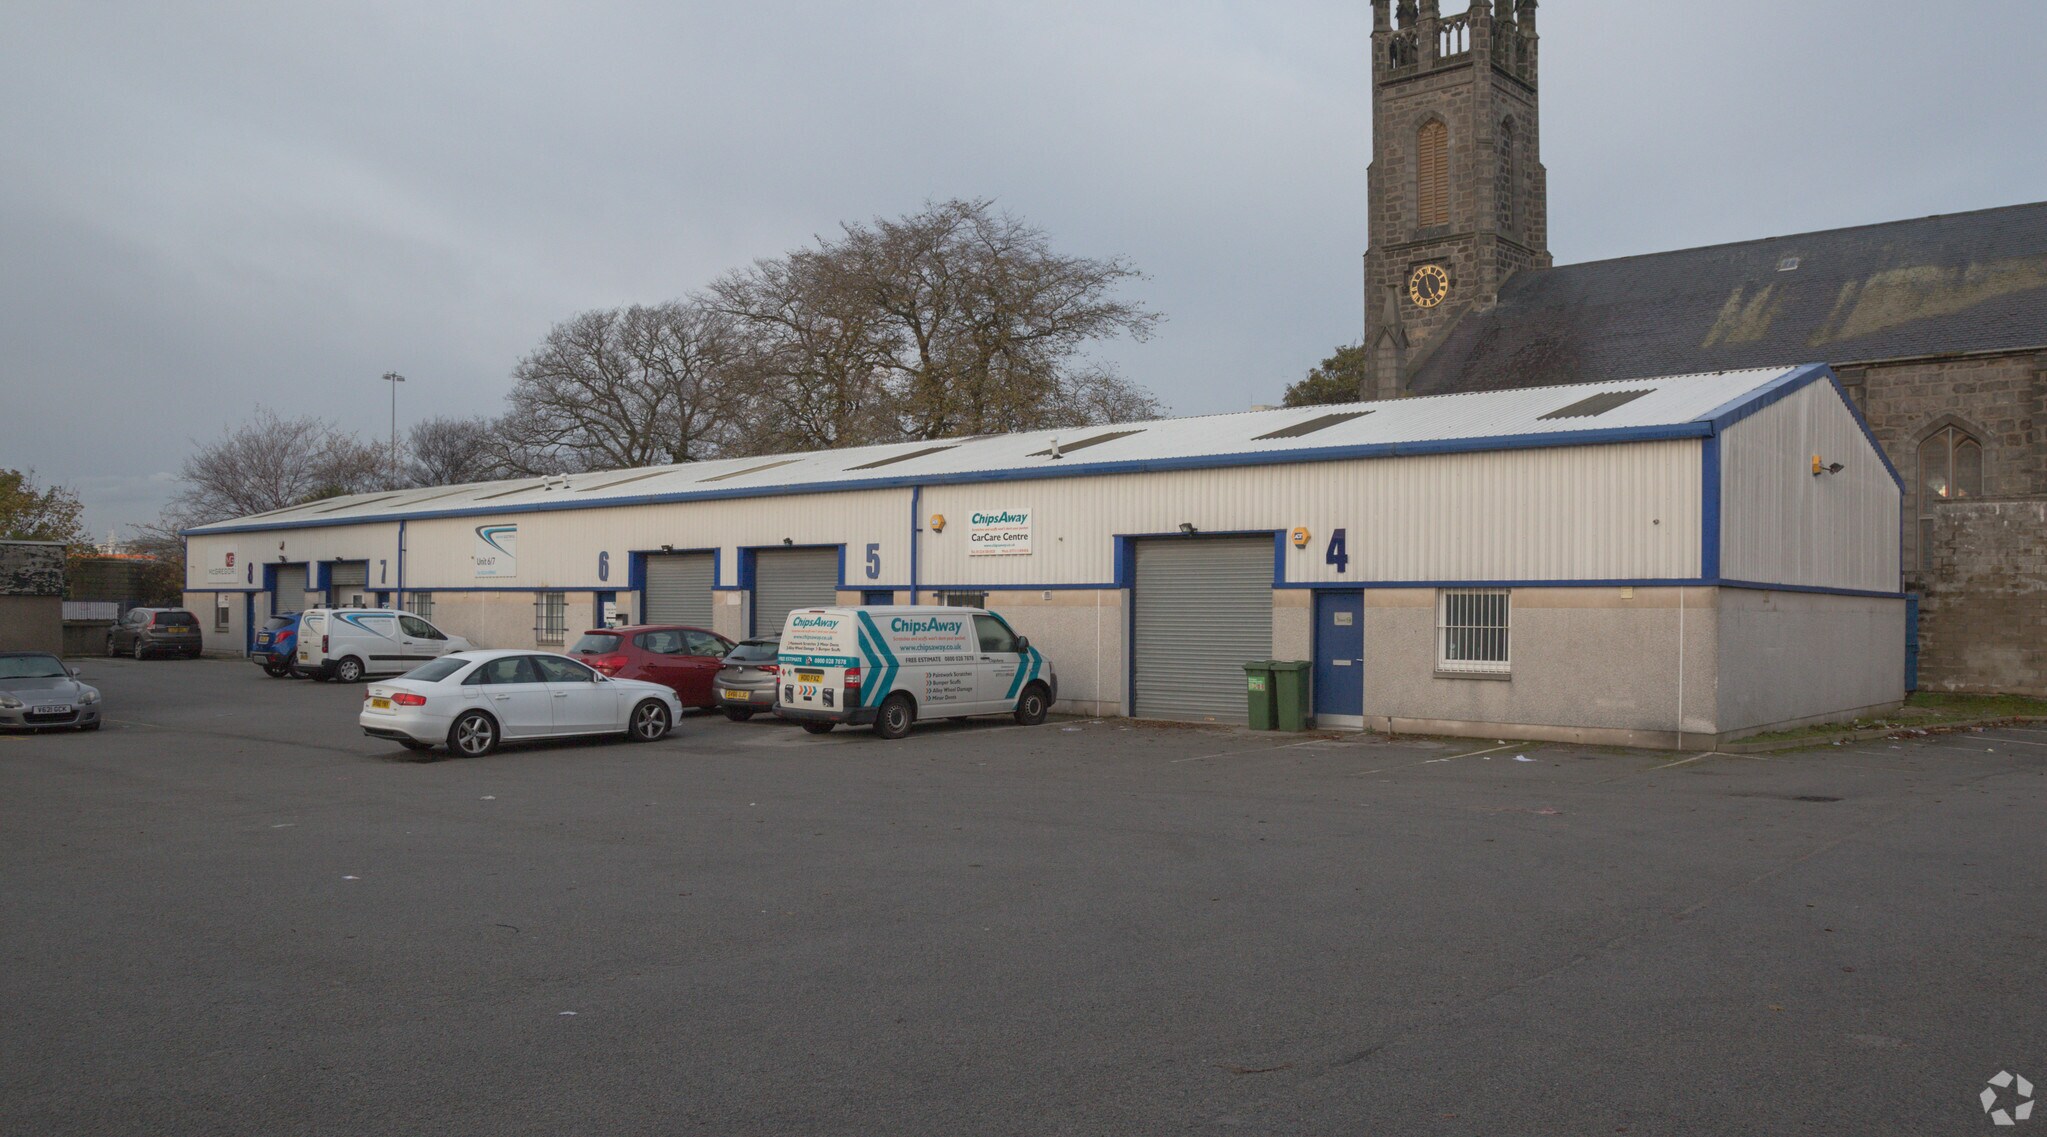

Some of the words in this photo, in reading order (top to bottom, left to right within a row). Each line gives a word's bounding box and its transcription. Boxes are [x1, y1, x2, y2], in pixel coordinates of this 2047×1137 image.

[972, 512, 1028, 526] ChipsAway
[972, 533, 1001, 541] CarCare
[1326, 529, 1348, 572] 4
[598, 550, 609, 582] 6
[866, 543, 880, 580] 5
[248, 562, 253, 584] 8
[380, 560, 386, 584] 7
[793, 616, 839, 630] ChipsAway
[891, 617, 962, 635] ChipsAway
[900, 643, 962, 652] www.chipsaway.co.uk
